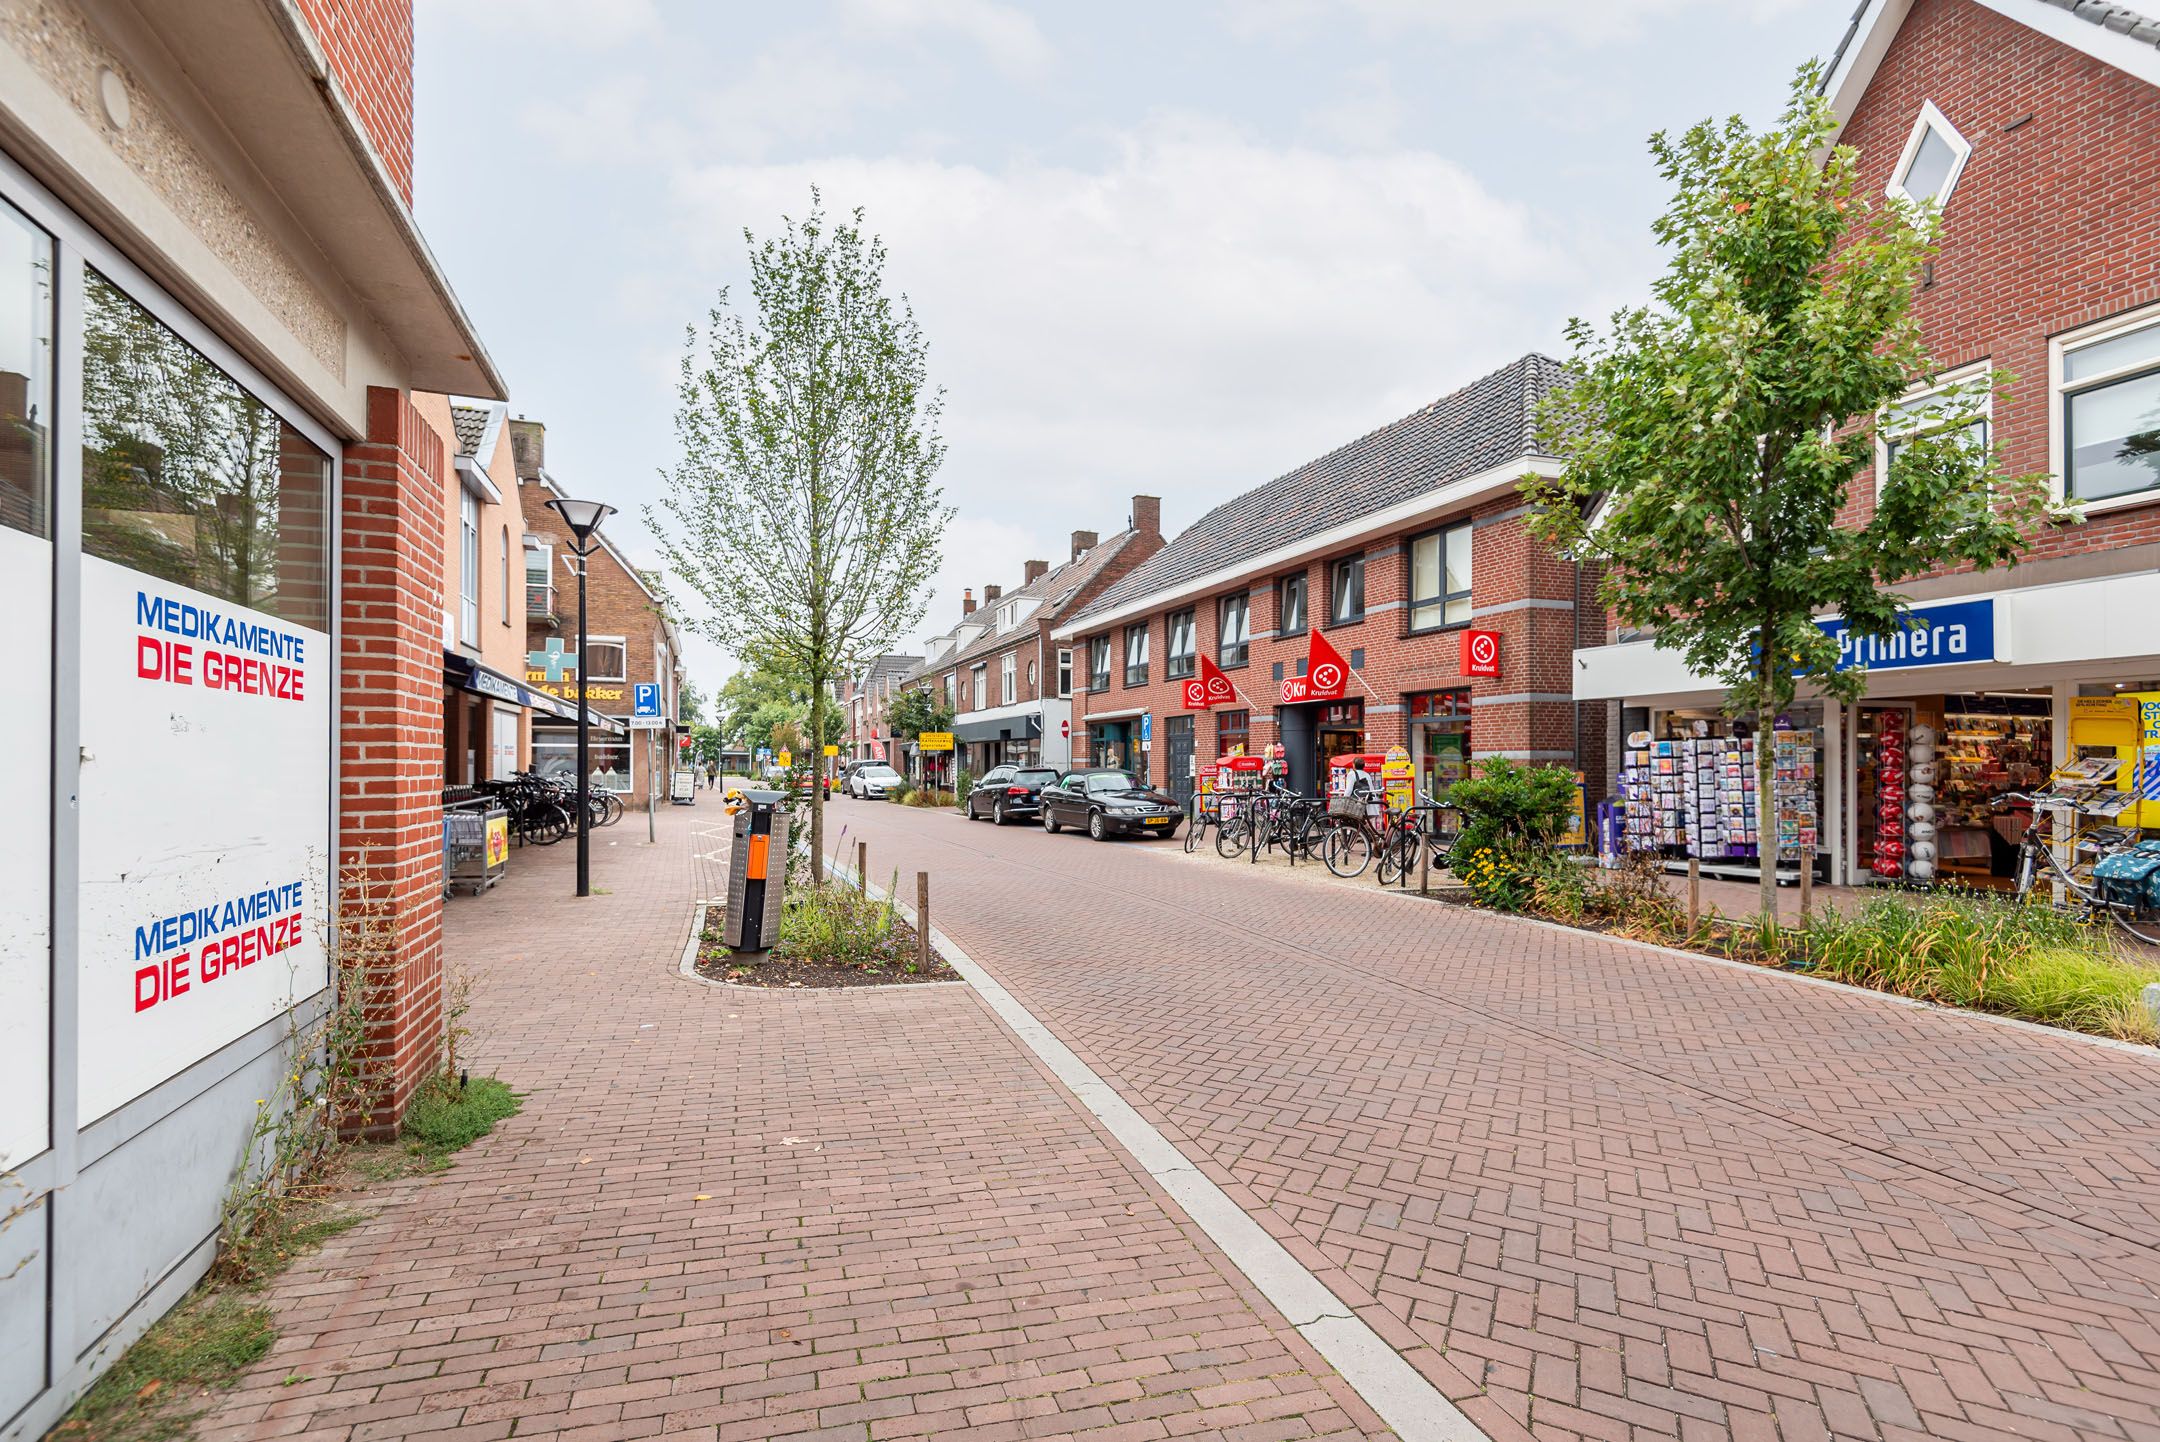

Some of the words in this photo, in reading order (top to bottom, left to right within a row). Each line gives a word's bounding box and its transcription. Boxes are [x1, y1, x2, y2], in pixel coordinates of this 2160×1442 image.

[137, 591, 304, 663] MEDIKAMENTE
[1836, 624, 1967, 664] Primera
[138, 635, 193, 685] DIE
[203, 650, 304, 701] GRENZE
[640, 686, 652, 703] P
[1143, 717, 1149, 730] P
[135, 881, 302, 961] MEDIKAMENTE
[135, 952, 190, 1013] DIE
[201, 912, 302, 984] GRENZE
